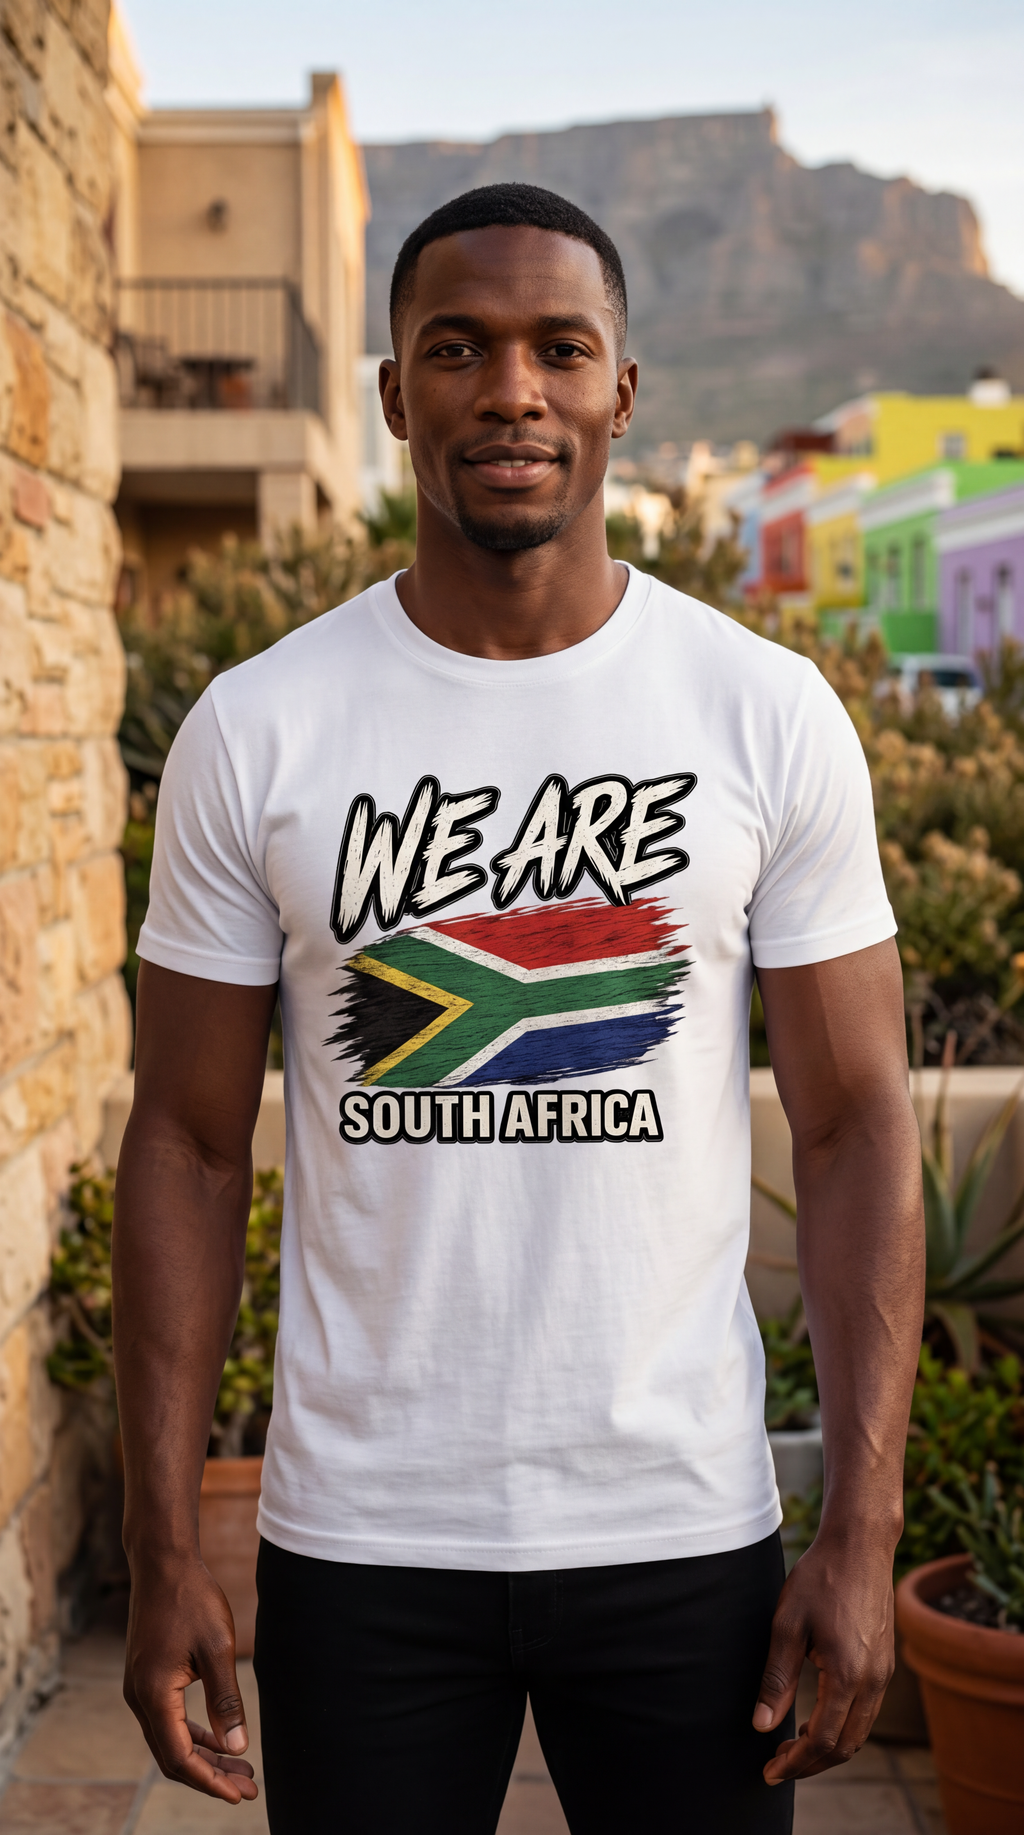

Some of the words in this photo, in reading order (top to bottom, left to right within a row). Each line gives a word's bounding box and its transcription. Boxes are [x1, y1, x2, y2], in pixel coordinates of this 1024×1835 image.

[331, 775, 499, 943] WE
[491, 774, 696, 909] ARE
[340, 1091, 494, 1143] SOUTH
[500, 1090, 663, 1142] AFRICA
